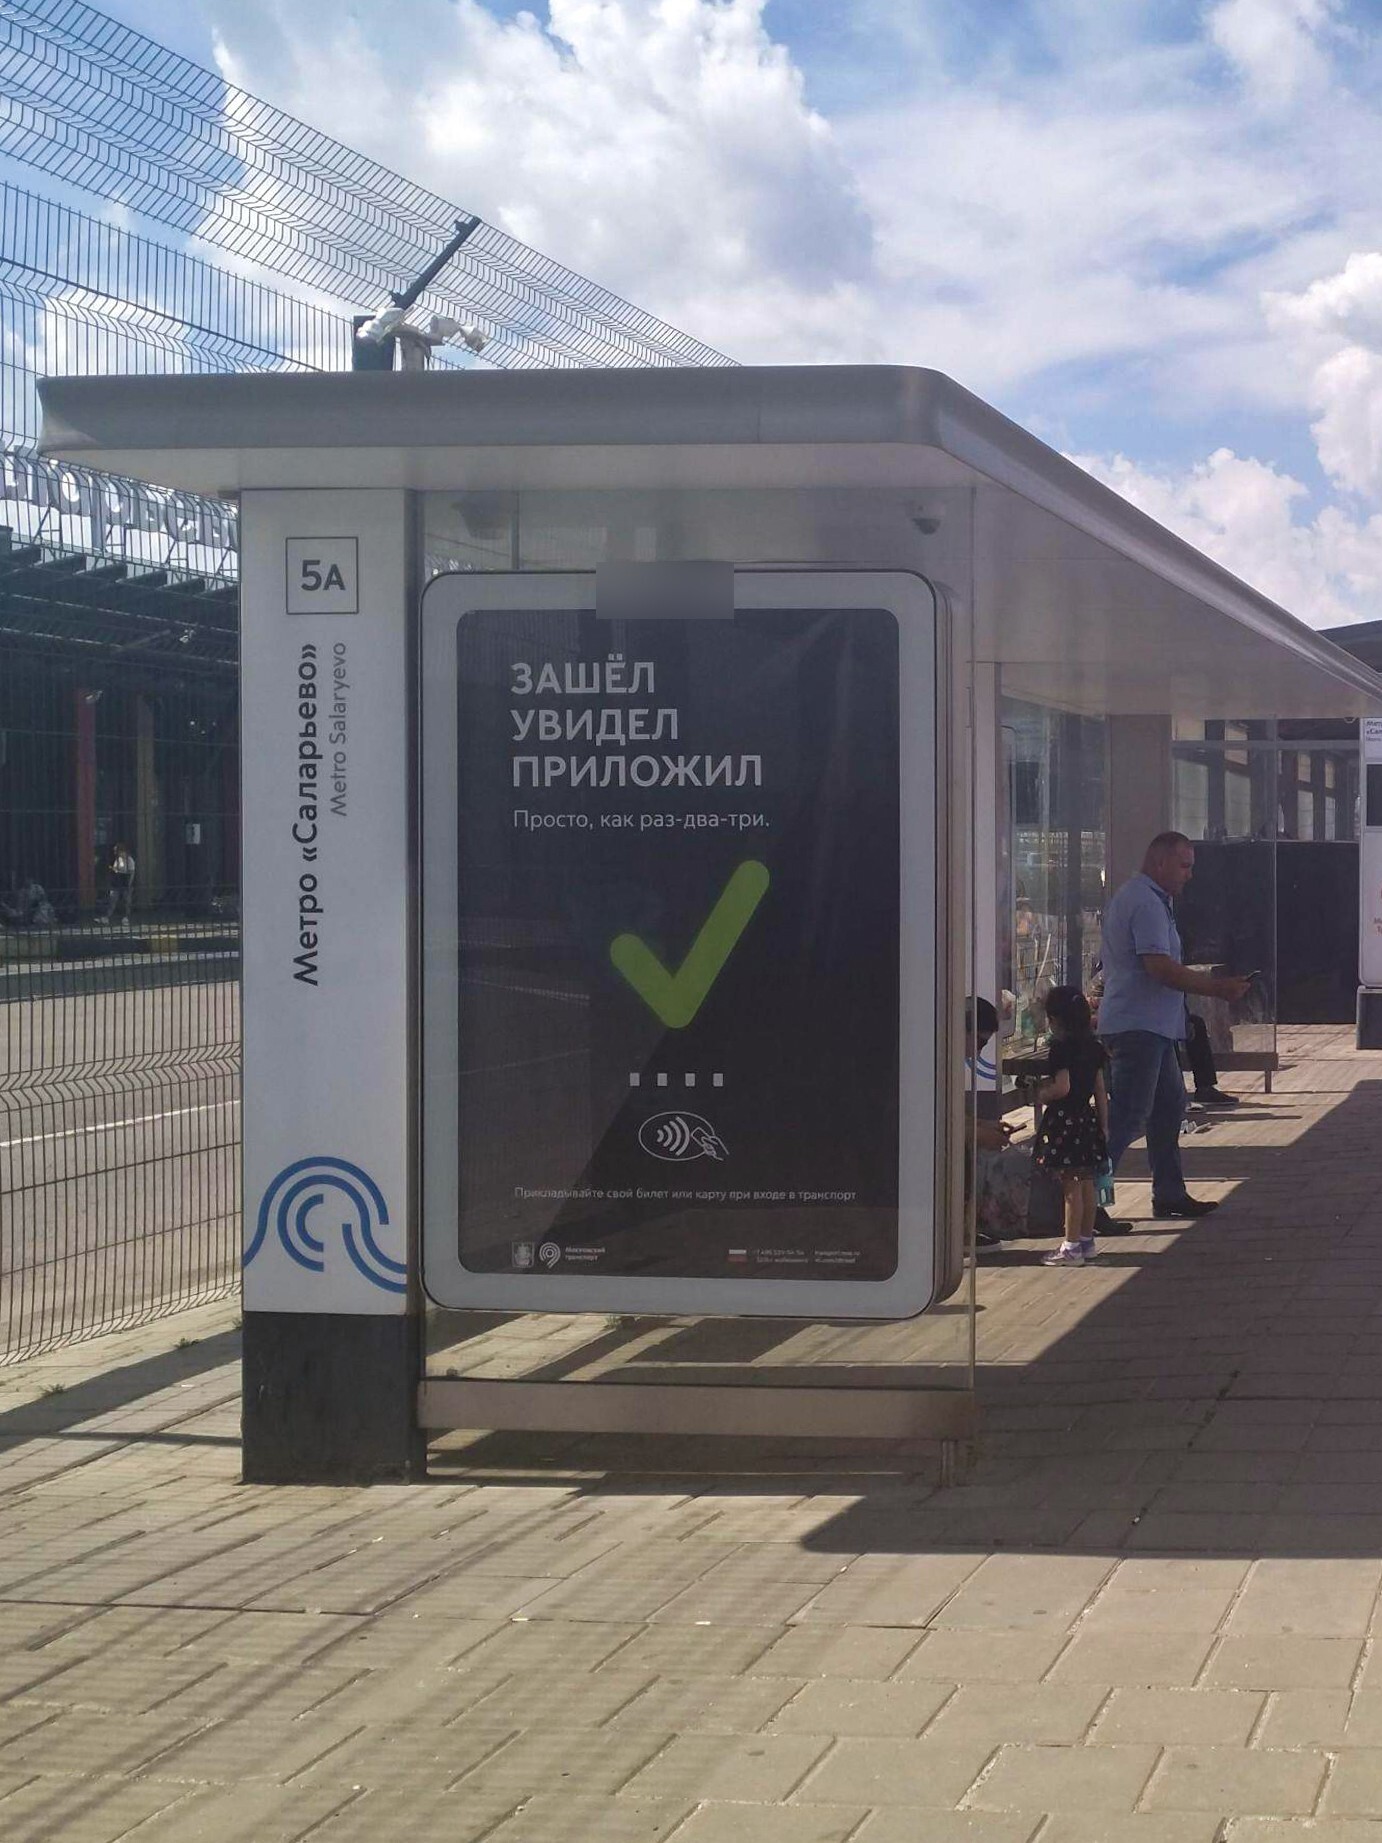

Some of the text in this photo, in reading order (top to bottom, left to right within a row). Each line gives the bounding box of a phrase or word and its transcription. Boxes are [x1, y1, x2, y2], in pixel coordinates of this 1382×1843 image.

[510, 653, 656, 695] ЗАШЁЛ
[328, 641, 350, 817] Metro Salaryevo
[510, 708, 679, 746] УВИДЕЛ
[512, 754, 762, 788] ПРИЛОЖИЛ
[291, 643, 324, 987] Метро «Саларьево»
[513, 809, 770, 832] Просто, как раз-два-три.
[606, 1187, 634, 1199] свой
[636, 1187, 669, 1199] билет
[672, 1190, 693, 1199] или
[695, 1190, 727, 1201] карту
[729, 1190, 750, 1201] при
[753, 1191, 787, 1200] входе
[799, 1191, 858, 1202] транспорт
